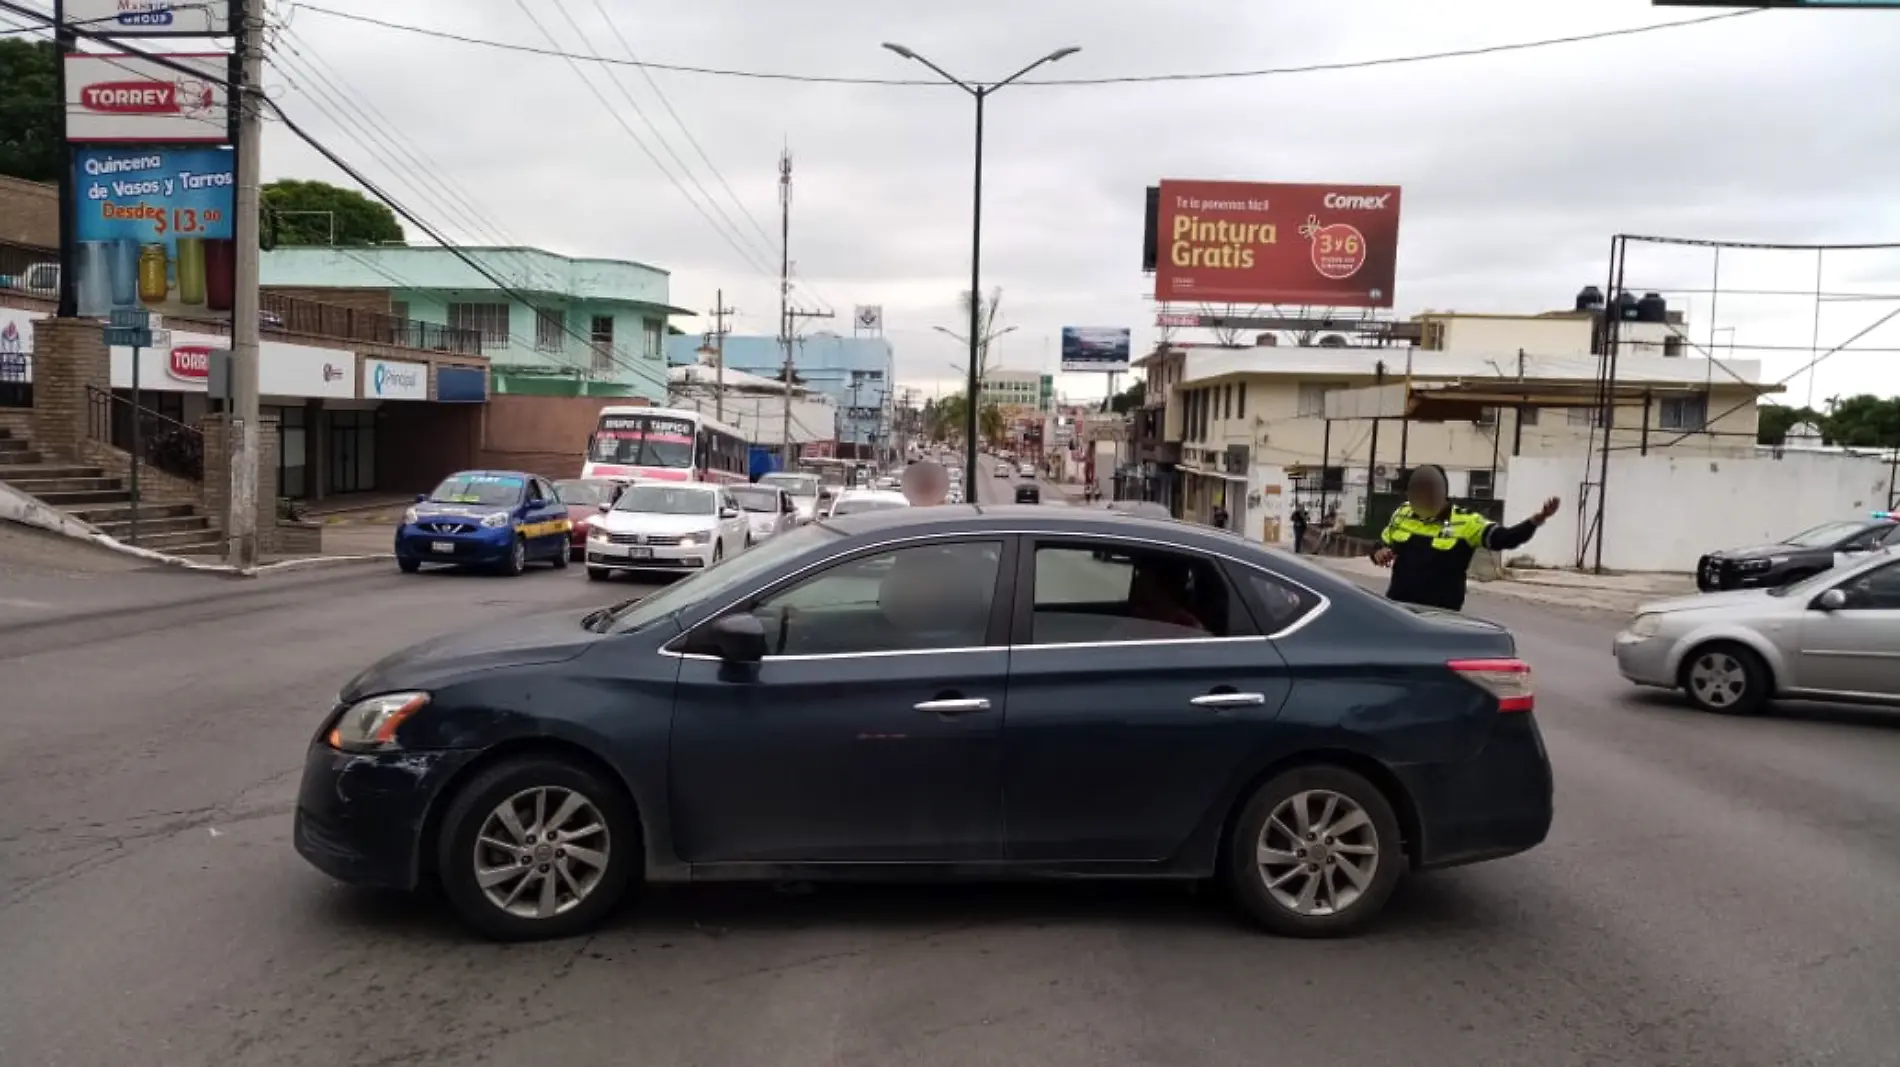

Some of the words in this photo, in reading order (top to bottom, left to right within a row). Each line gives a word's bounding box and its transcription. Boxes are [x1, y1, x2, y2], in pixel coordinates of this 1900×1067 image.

[87, 88, 170, 105] TORREY
[85, 155, 161, 176] Quincena
[88, 182, 108, 200] de
[112, 179, 160, 197] Vasos
[164, 178, 174, 196] y
[179, 170, 233, 189] Tarros
[1176, 196, 1188, 209] Te
[1201, 199, 1246, 213] ponemos
[1323, 192, 1391, 210] Comex
[102, 202, 157, 219] Desde
[1173, 215, 1277, 244] Pintura
[1171, 240, 1255, 269] Gratis
[174, 352, 208, 370] TORR
